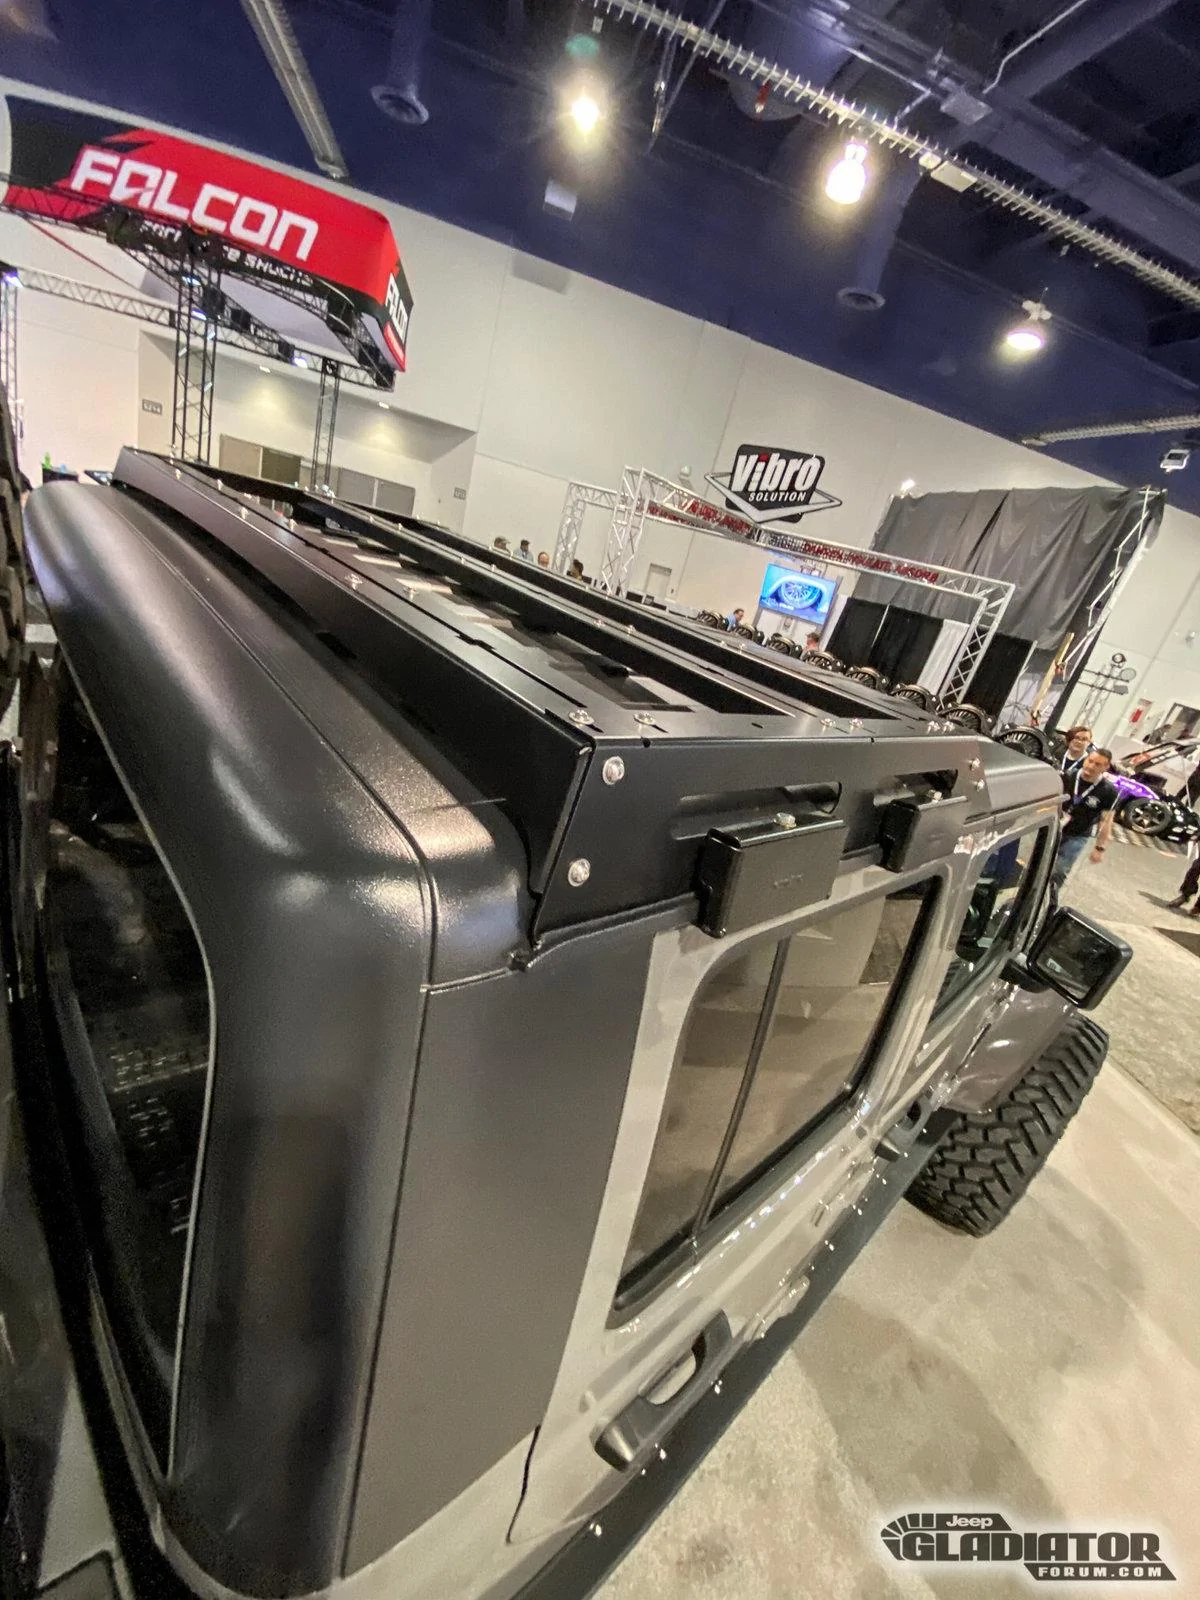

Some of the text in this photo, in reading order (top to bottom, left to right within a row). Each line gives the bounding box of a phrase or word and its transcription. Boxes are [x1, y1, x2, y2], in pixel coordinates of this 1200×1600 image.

[70, 149, 319, 262] FALCON
[731, 453, 820, 492] Vibro
[749, 491, 807, 503] SOLUTION
